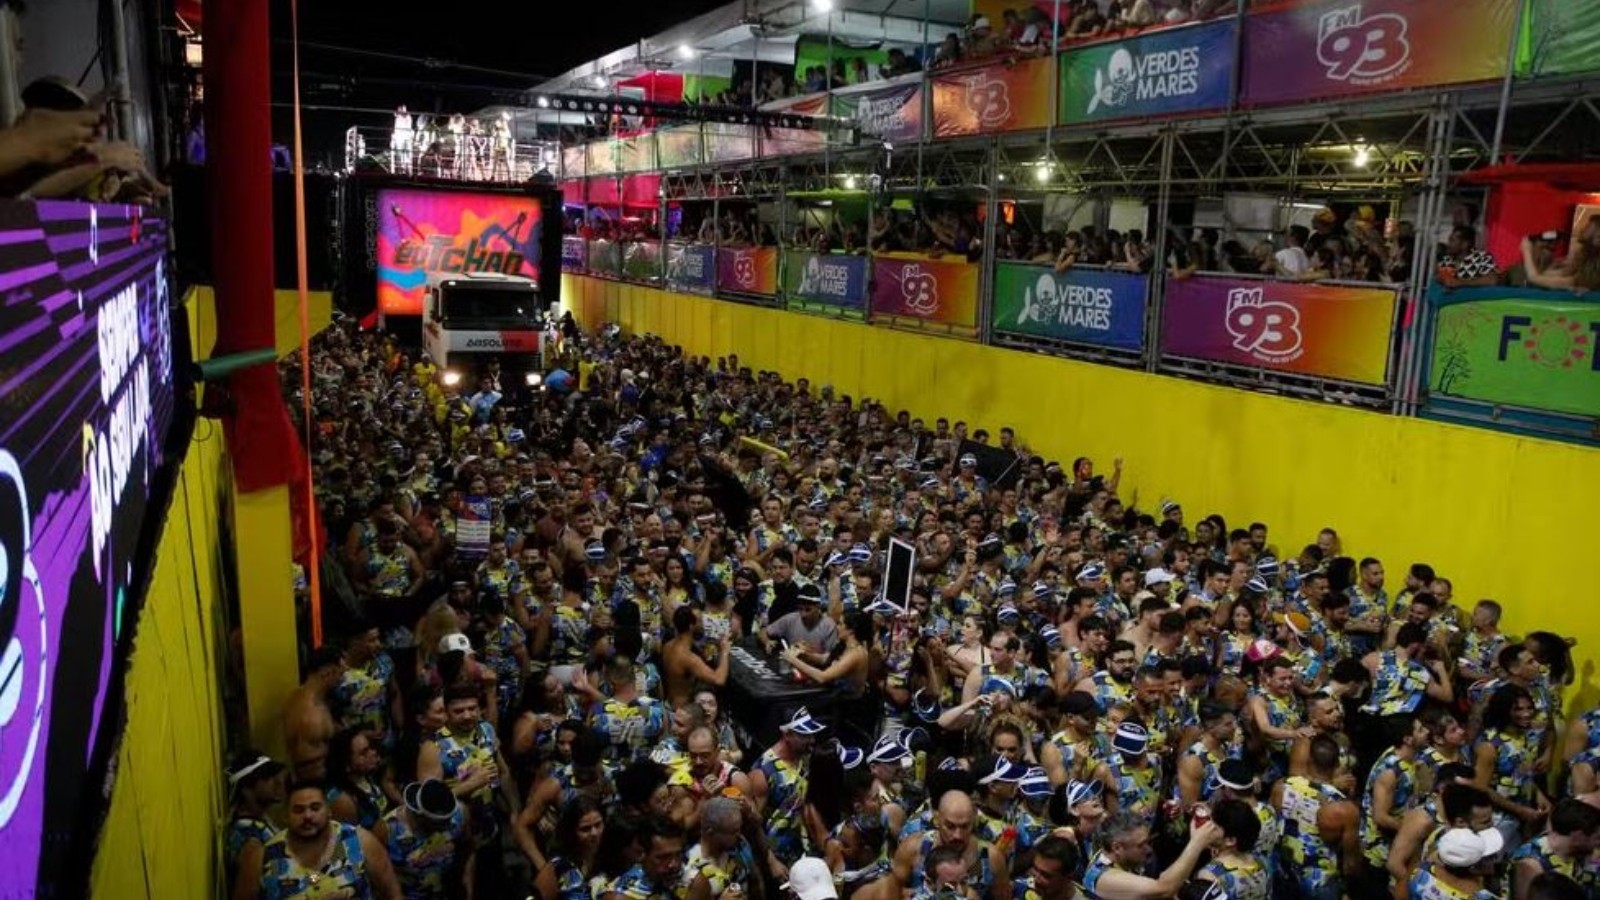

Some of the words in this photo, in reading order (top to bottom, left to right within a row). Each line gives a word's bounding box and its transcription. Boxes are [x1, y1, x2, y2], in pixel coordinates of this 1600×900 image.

[1136, 46, 1200, 77] VERDES
[1317, 13, 1409, 80] 93
[1136, 71, 1198, 100] MARES
[902, 273, 938, 308] 93
[1058, 284, 1113, 309] VERDES
[1227, 287, 1263, 312] FM
[1059, 305, 1111, 330] MARES
[1225, 301, 1302, 352] 93
